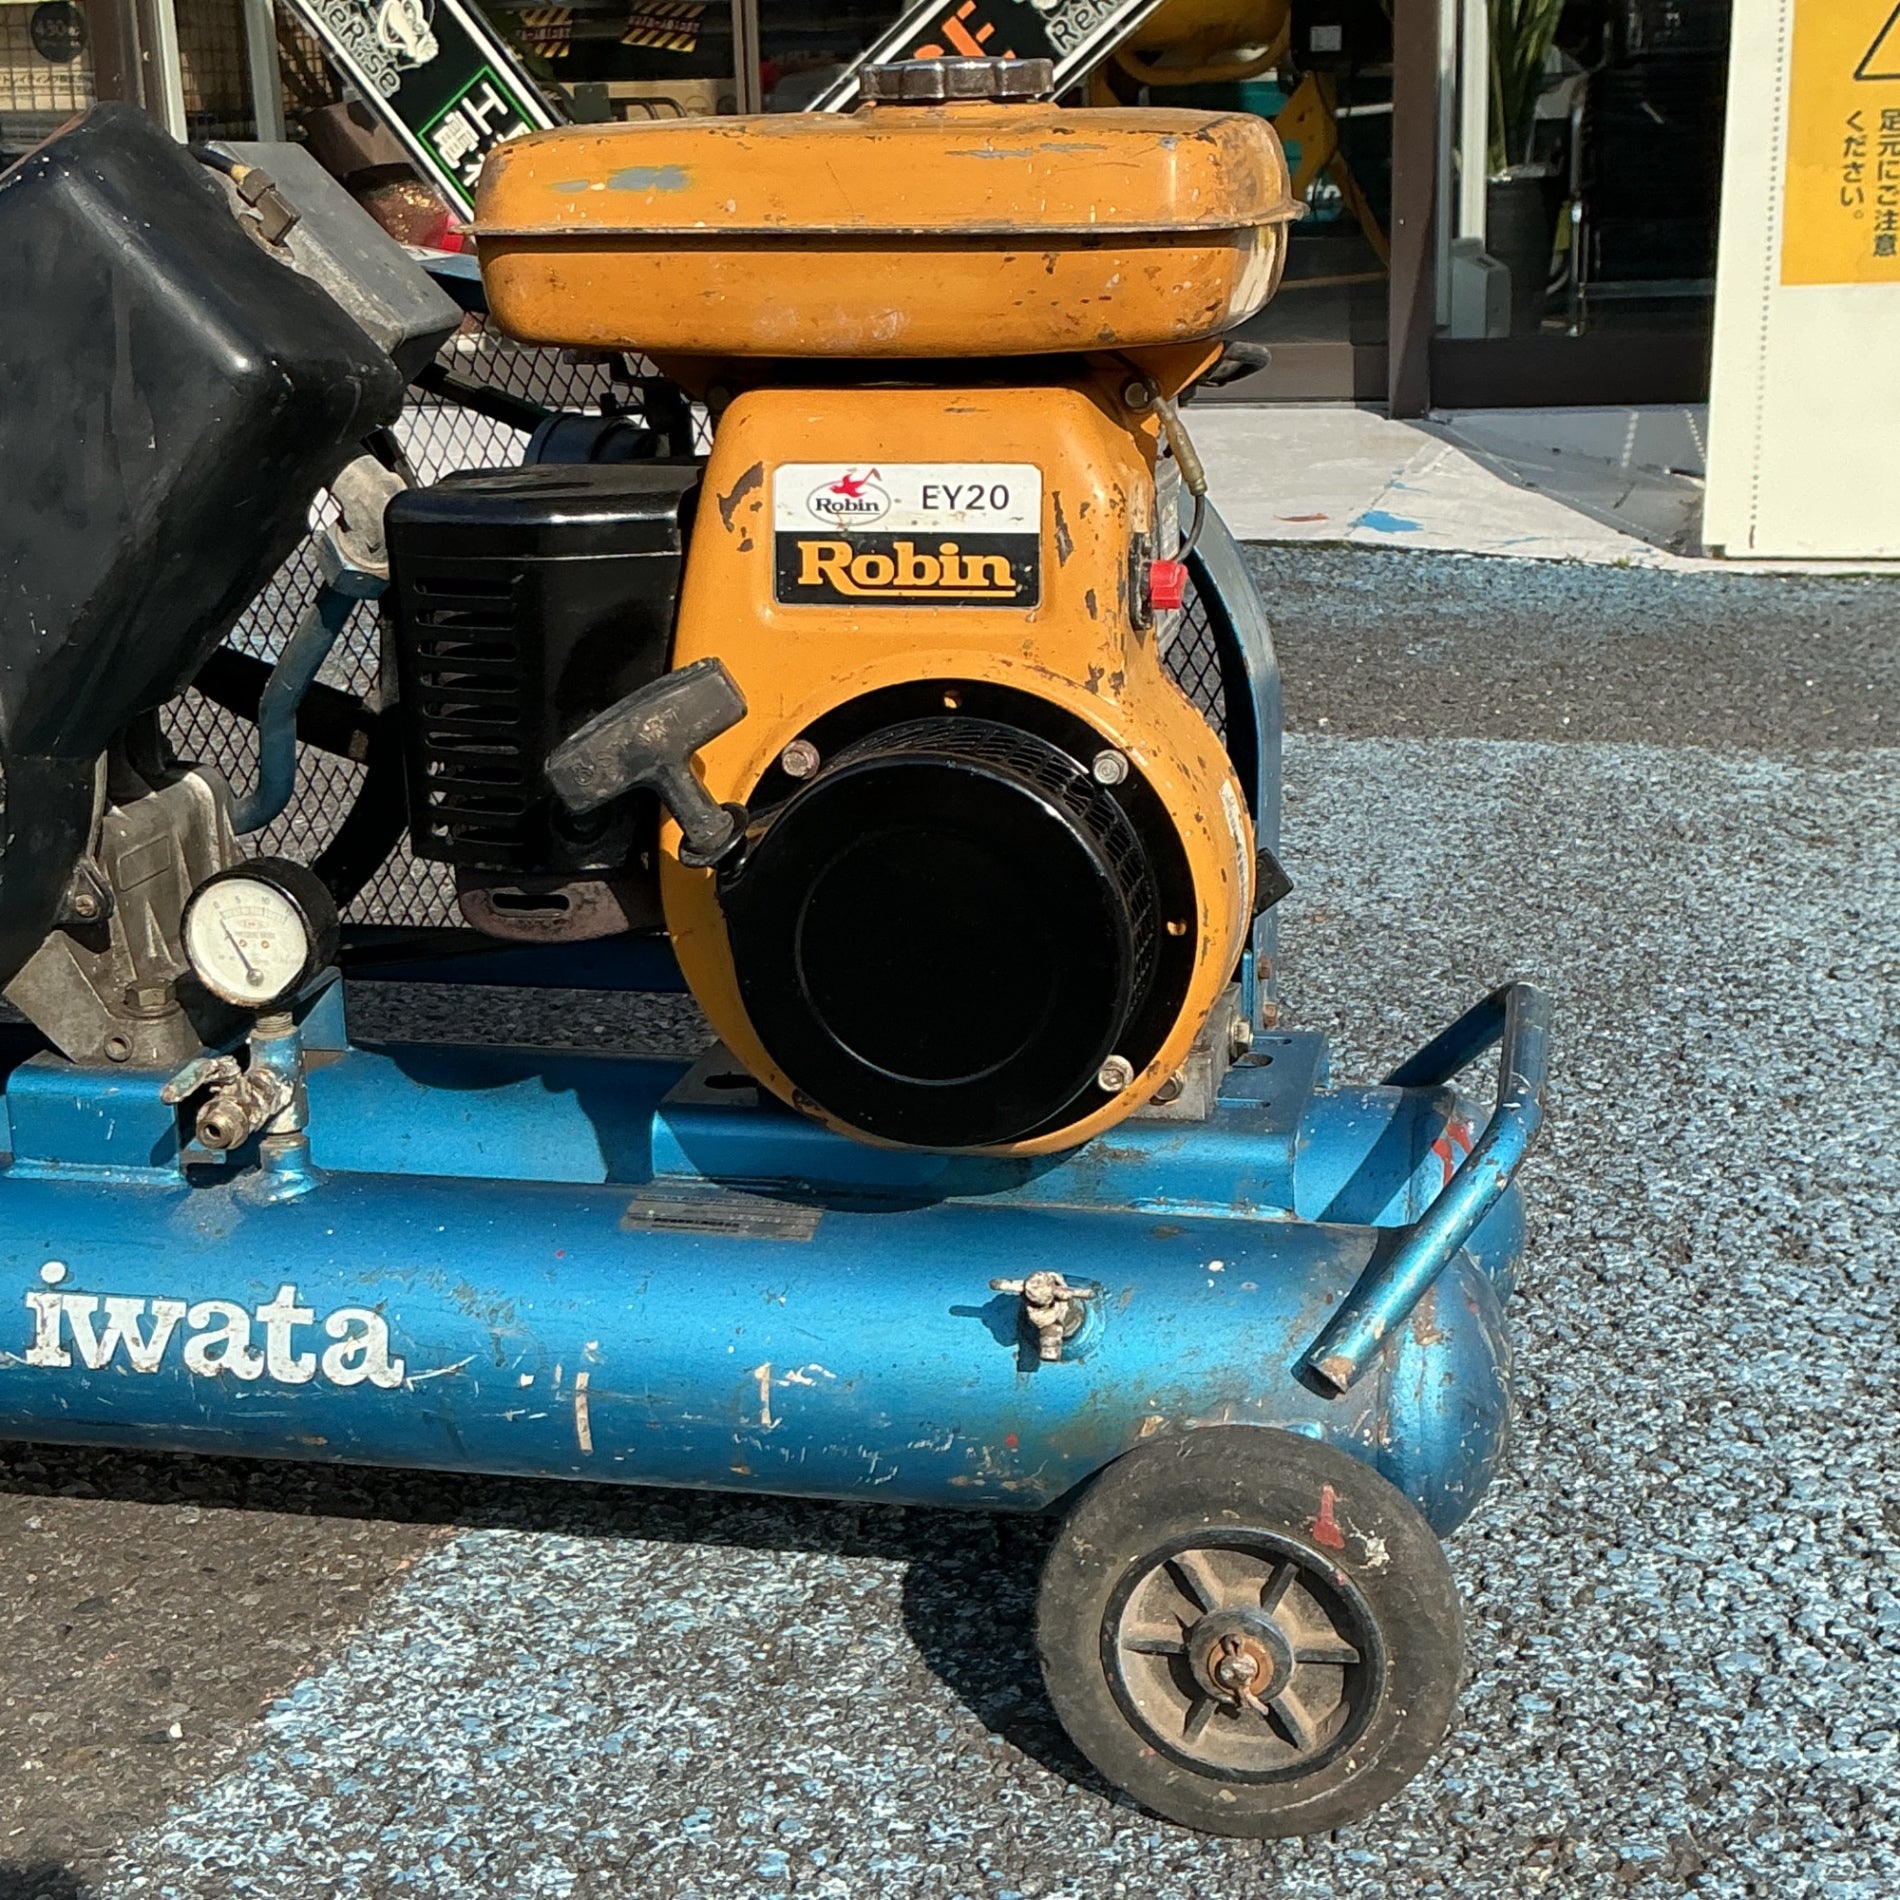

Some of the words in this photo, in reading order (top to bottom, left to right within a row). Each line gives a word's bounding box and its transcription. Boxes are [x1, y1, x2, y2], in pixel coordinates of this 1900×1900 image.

[1840, 110, 1867, 220] ください。
[1873, 108, 1900, 257] 足元にご注意
[815, 497, 880, 515] Robin
[921, 484, 1010, 511] EY20
[797, 540, 1017, 598] Robin
[25, 1261, 406, 1389] iwata
